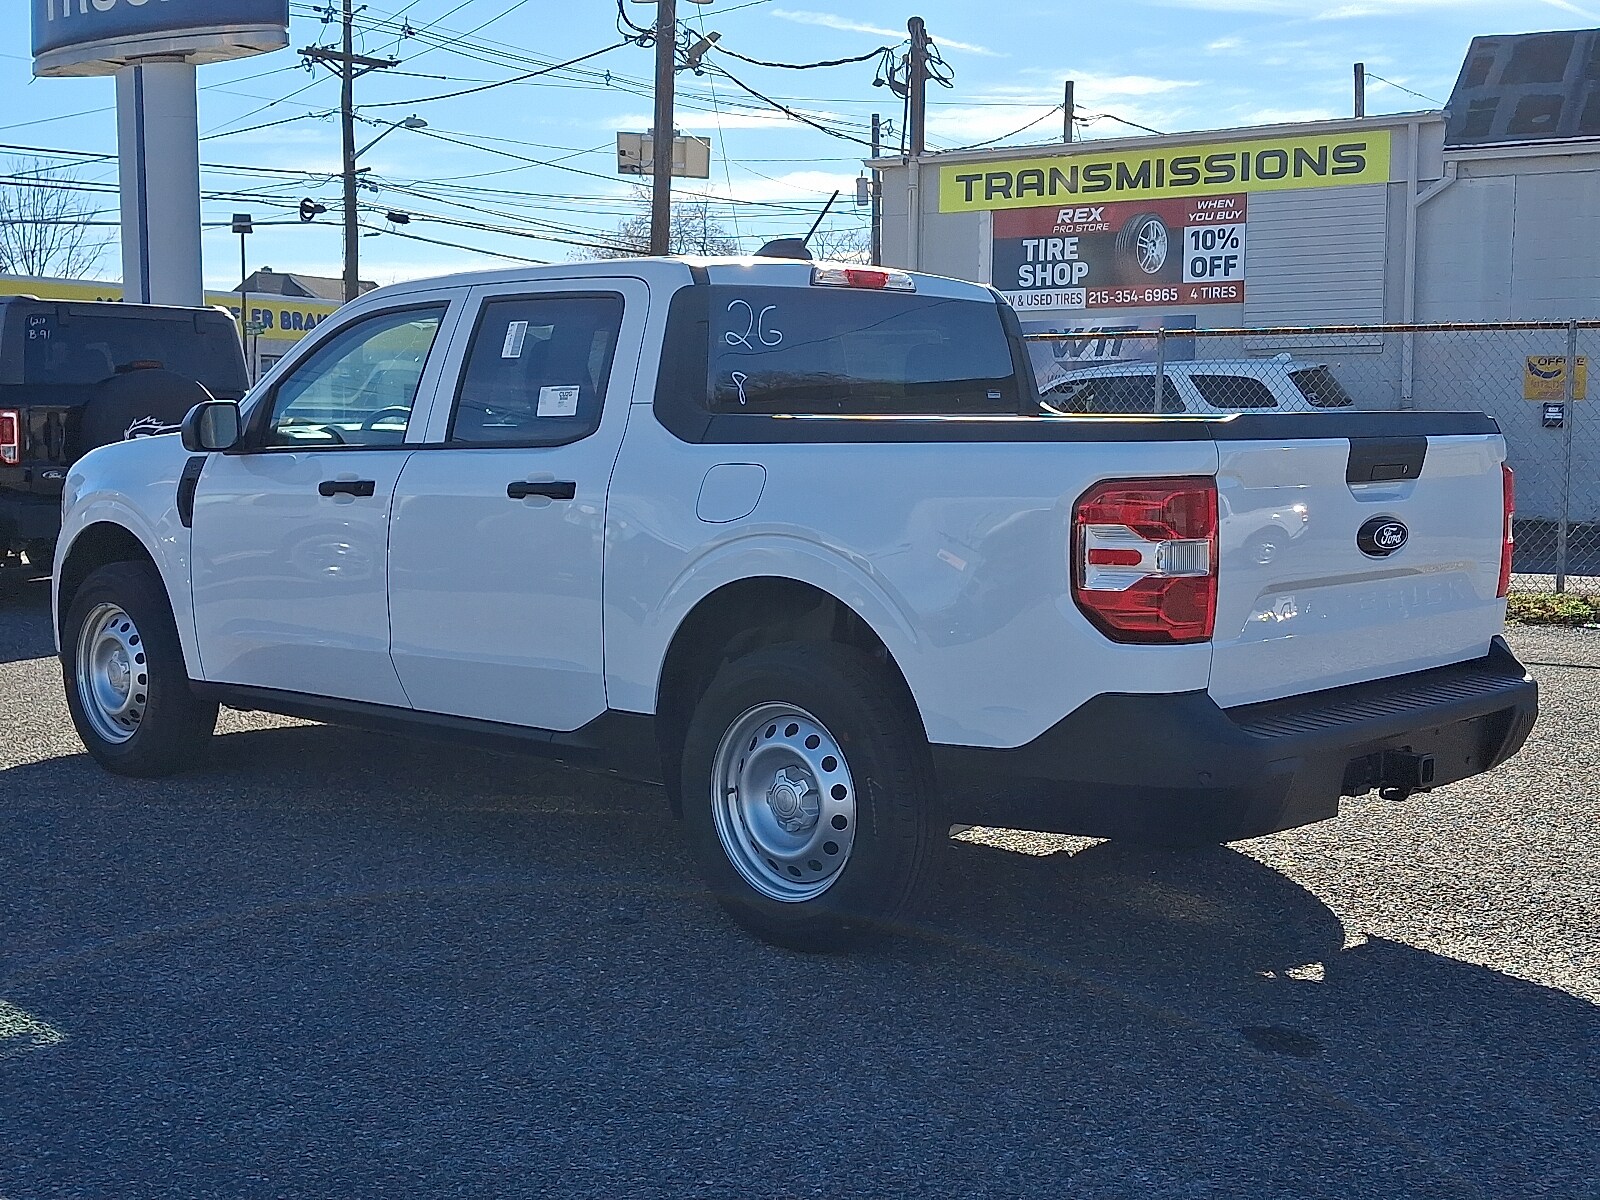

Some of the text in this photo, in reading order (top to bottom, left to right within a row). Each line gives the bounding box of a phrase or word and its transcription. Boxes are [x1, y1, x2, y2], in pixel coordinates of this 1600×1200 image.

[955, 142, 1367, 202] TRANSMISSIONS
[1197, 199, 1235, 210] WHEN
[1056, 206, 1105, 224] REX
[1188, 210, 1243, 222] YOU BUY
[1052, 222, 1110, 234] PRO STORE
[1190, 227, 1240, 252] 10%
[1022, 237, 1079, 262] TIRE
[1018, 262, 1089, 287] SHOP
[1190, 254, 1238, 278] OFF
[1017, 294, 1024, 307] &
[1026, 293, 1053, 306] USED
[1054, 292, 1083, 305] TIRES
[1088, 288, 1178, 304] 215-354-6965
[1190, 286, 1237, 299] 4 TIRES
[725, 299, 783, 350] 26
[1537, 357, 1585, 367] OFFIE
[731, 371, 748, 405] 8
[1380, 526, 1402, 545] Ford
